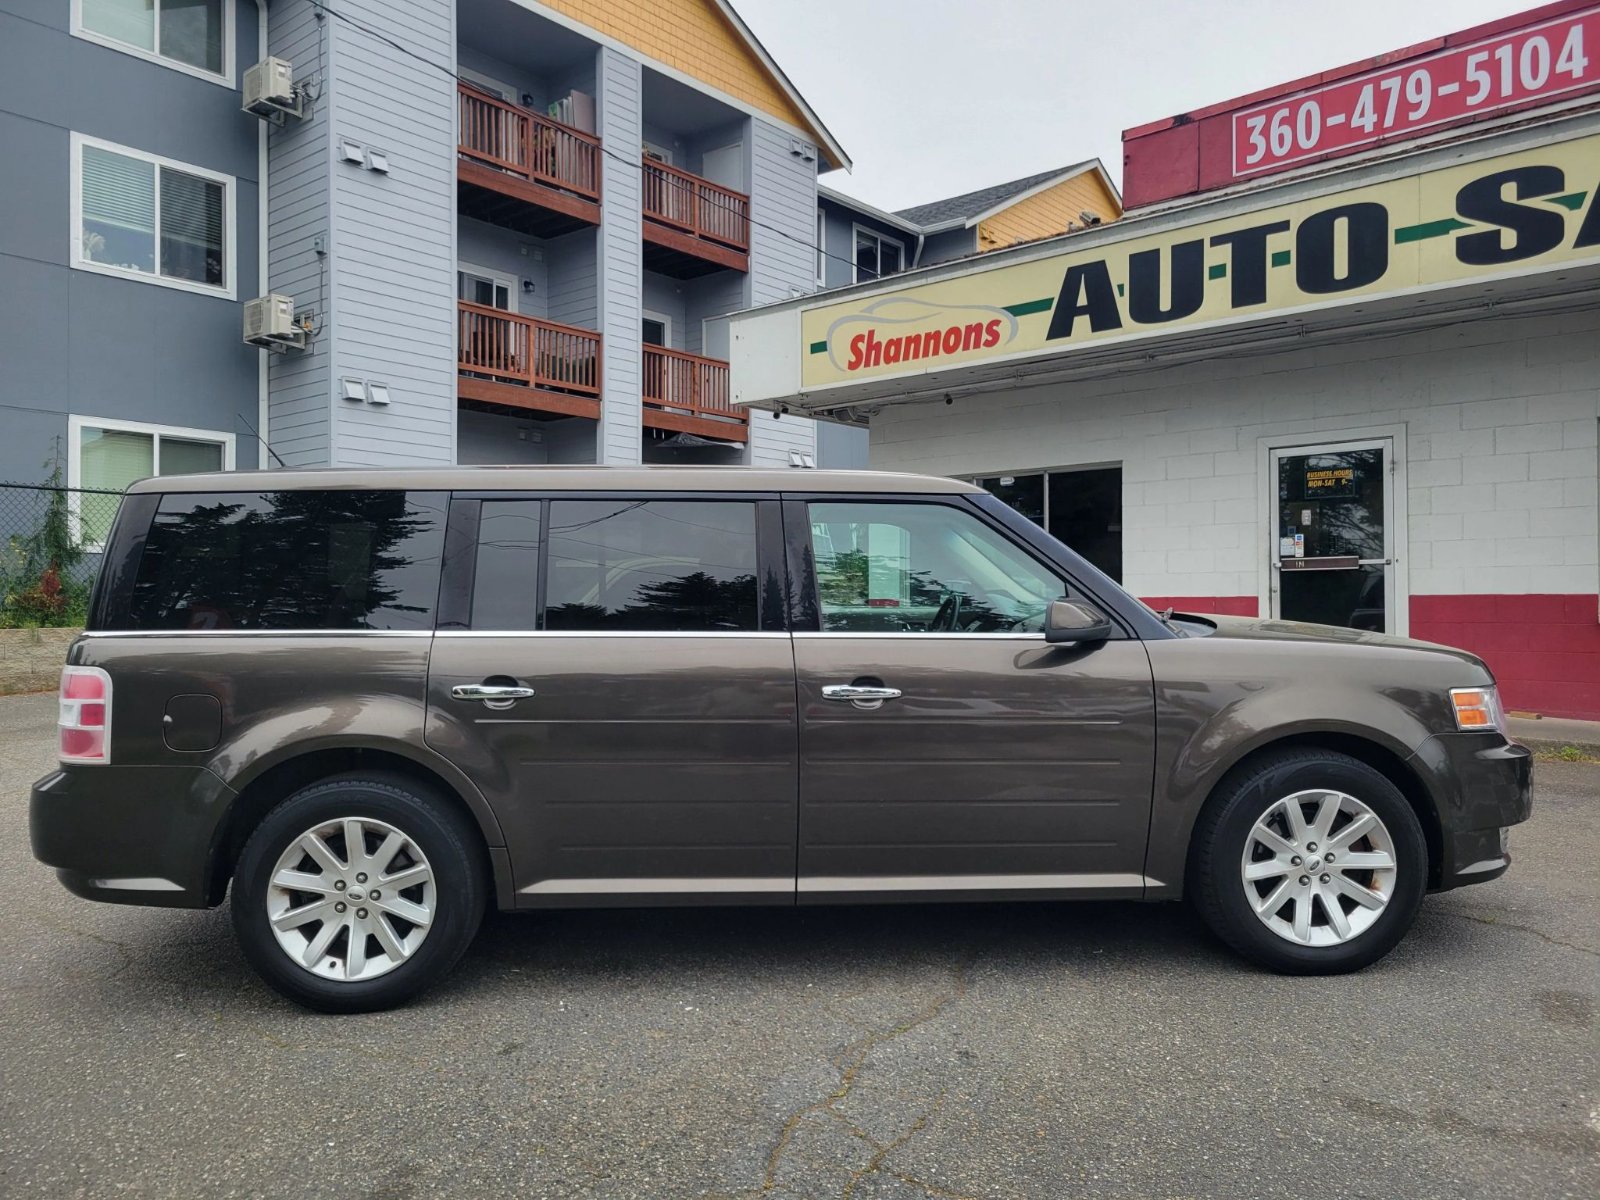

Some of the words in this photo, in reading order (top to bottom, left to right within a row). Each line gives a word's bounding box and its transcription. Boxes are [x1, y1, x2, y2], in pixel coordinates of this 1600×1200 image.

[1246, 24, 1588, 164] 360-479-5104
[847, 319, 1002, 371] Shannons
[1045, 202, 1389, 341] AUTO
[1456, 165, 1600, 265] S
[1308, 479, 1336, 488] MON-SAT
[1296, 560, 1305, 568] IN
